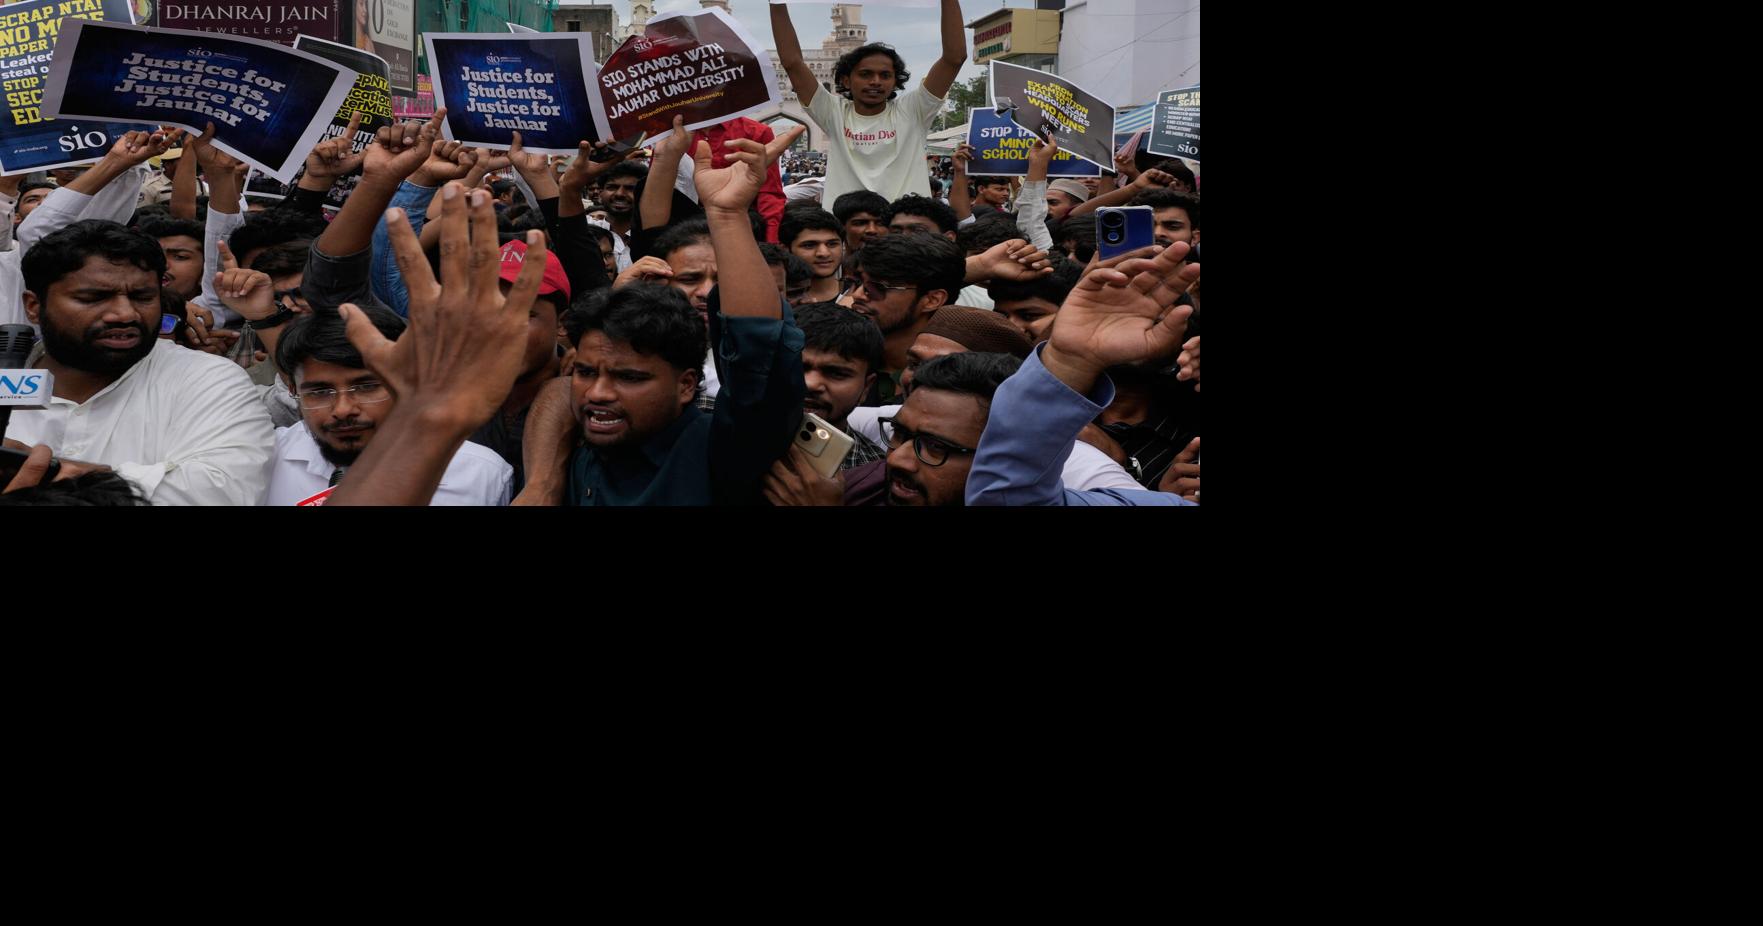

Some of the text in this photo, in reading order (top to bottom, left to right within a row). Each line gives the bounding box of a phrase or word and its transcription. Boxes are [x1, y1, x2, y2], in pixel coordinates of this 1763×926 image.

[0, 0, 102, 28] SCRAP NTA!
[166, 5, 328, 24] DHANRAJ JAIN
[0, 25, 31, 46] NO
[0, 39, 49, 58] PAPER
[187, 47, 213, 57] sio
[1, 65, 38, 79] steal
[123, 53, 238, 78] Justice
[241, 69, 286, 92] for
[461, 67, 554, 84] Justice for
[602, 43, 725, 88] SIO STANDS WITH
[3, 76, 40, 91] STOP
[128, 66, 269, 107] Students,
[612, 56, 727, 101] MOHAMMAD ALI
[114, 79, 271, 122] Justice for
[467, 82, 553, 103] Students,
[609, 65, 745, 120] JAUHAR UNIVERSITY
[1027, 80, 1089, 114] EXAMINATION
[1050, 82, 1073, 98] FROM
[1167, 92, 1188, 102] STOP
[136, 95, 242, 127] Jauhar
[467, 98, 560, 116] Justice for
[1024, 88, 1090, 126] HEADQUARTERS
[1028, 85, 1087, 119] HALL TO SCAM
[11, 106, 56, 125] ED
[485, 114, 547, 131] Jauhar
[1027, 96, 1086, 134] WHO RUNS
[1041, 109, 1072, 134] NEET?
[59, 125, 107, 152] sio
[980, 126, 1013, 138] STOP
[999, 138, 1037, 149] MINO
[1177, 141, 1198, 155] sio
